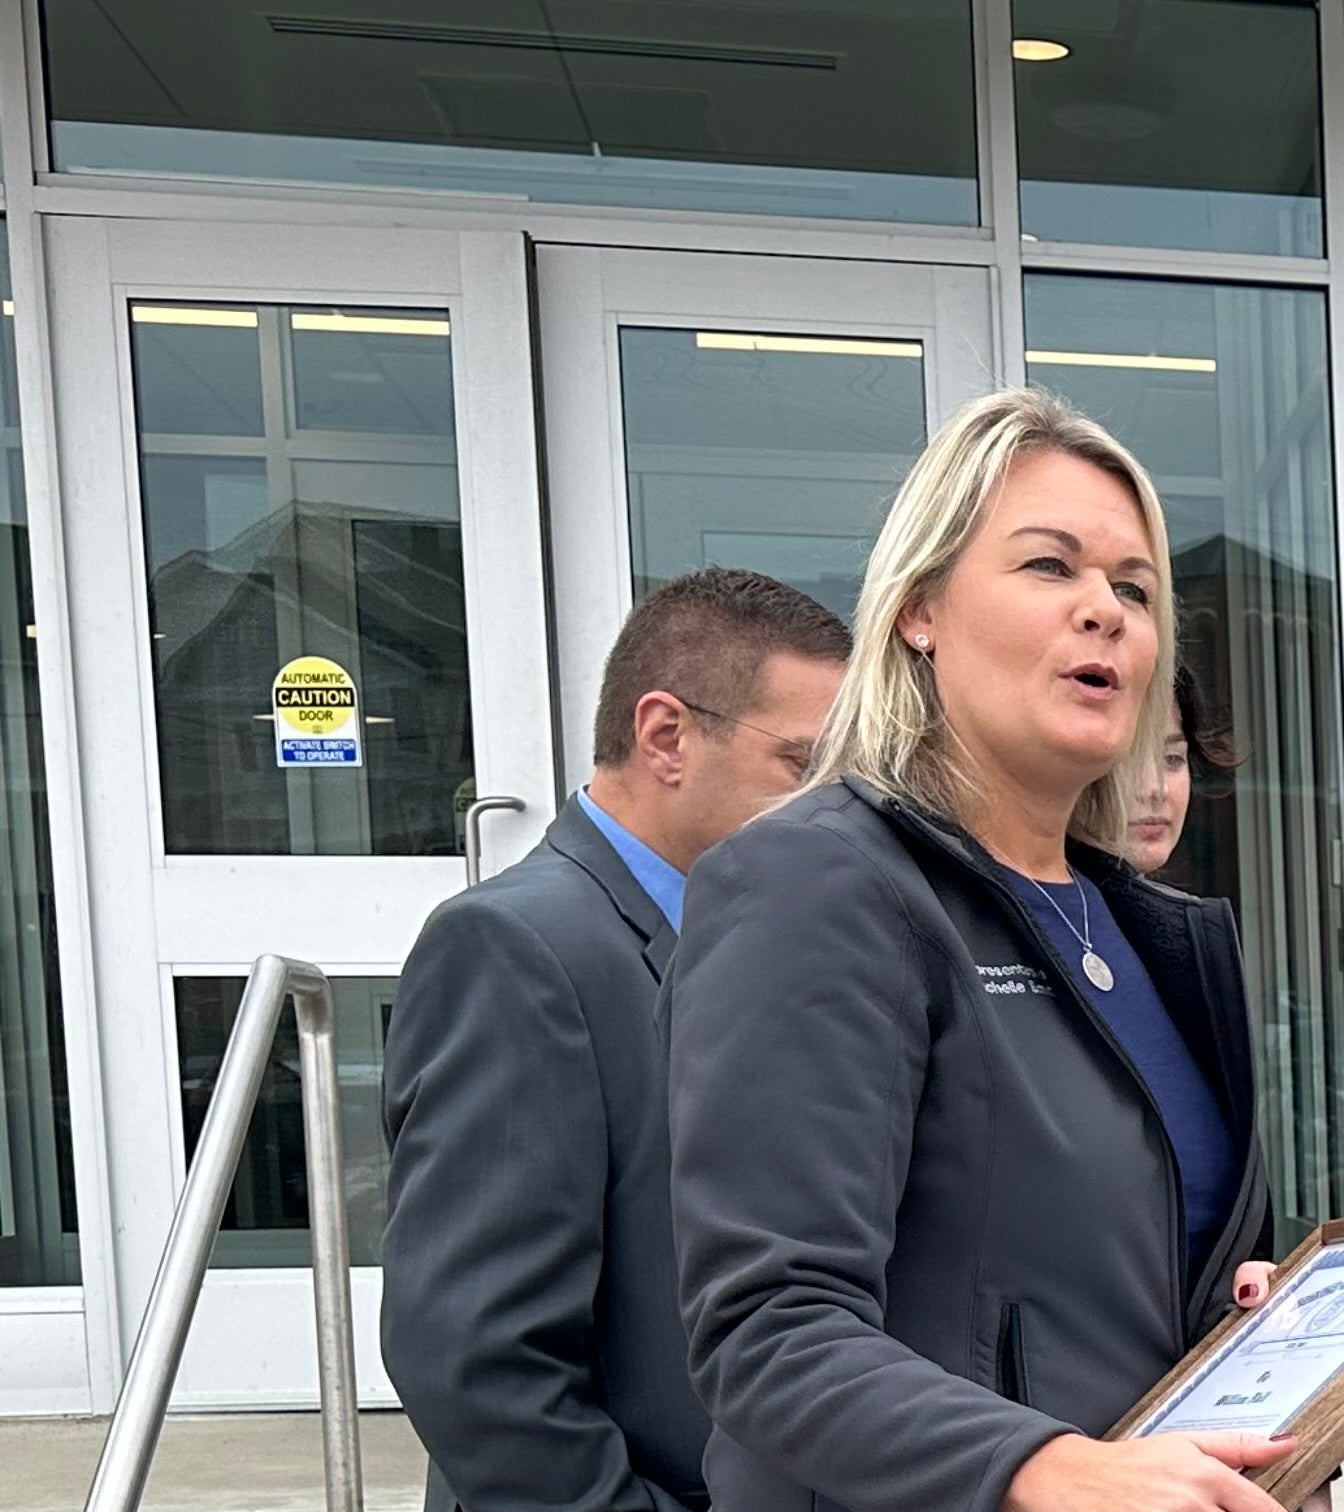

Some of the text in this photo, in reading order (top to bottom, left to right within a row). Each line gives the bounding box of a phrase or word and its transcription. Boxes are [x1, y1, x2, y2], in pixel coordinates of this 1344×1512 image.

[281, 673, 346, 684] AUTOMATIC
[277, 690, 352, 705] CAUTION
[298, 710, 334, 721] DOOR
[283, 741, 322, 751] ACTIVATE
[293, 751, 345, 761] TO OPERATE
